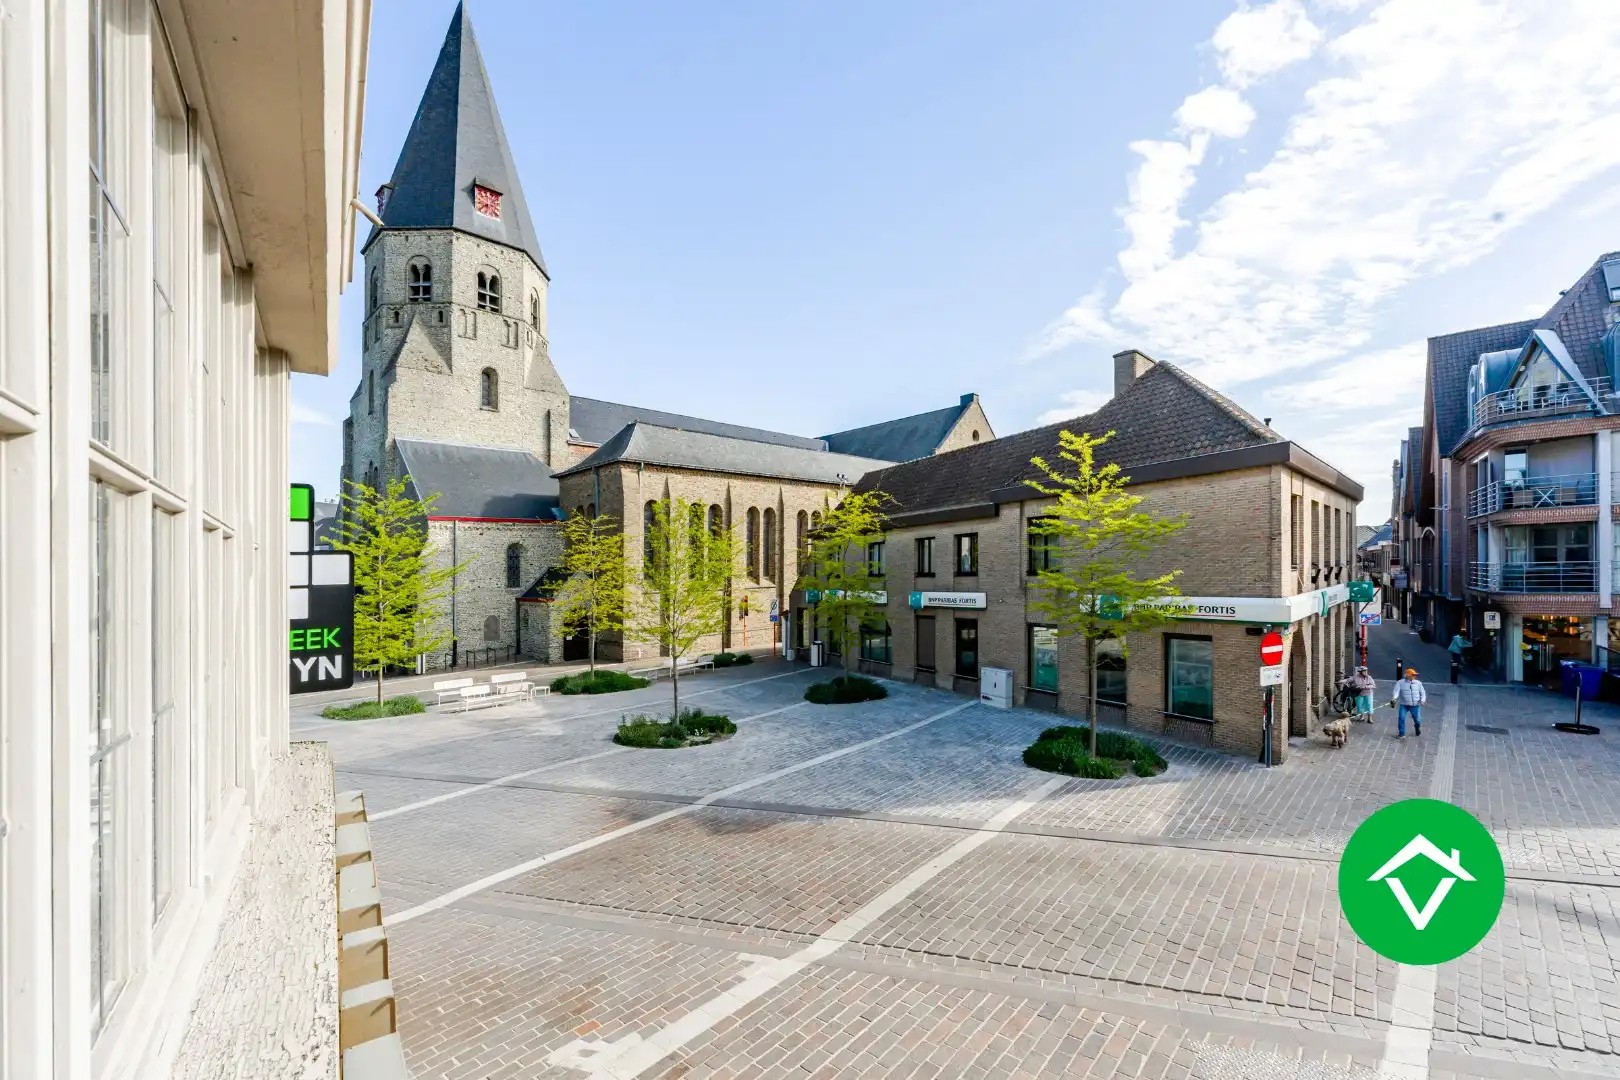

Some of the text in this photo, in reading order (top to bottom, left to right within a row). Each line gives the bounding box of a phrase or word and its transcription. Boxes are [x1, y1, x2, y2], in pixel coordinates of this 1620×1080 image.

[1198, 605, 1236, 615] FORTIS
[289, 627, 342, 651] EEK
[289, 654, 343, 682] YN
